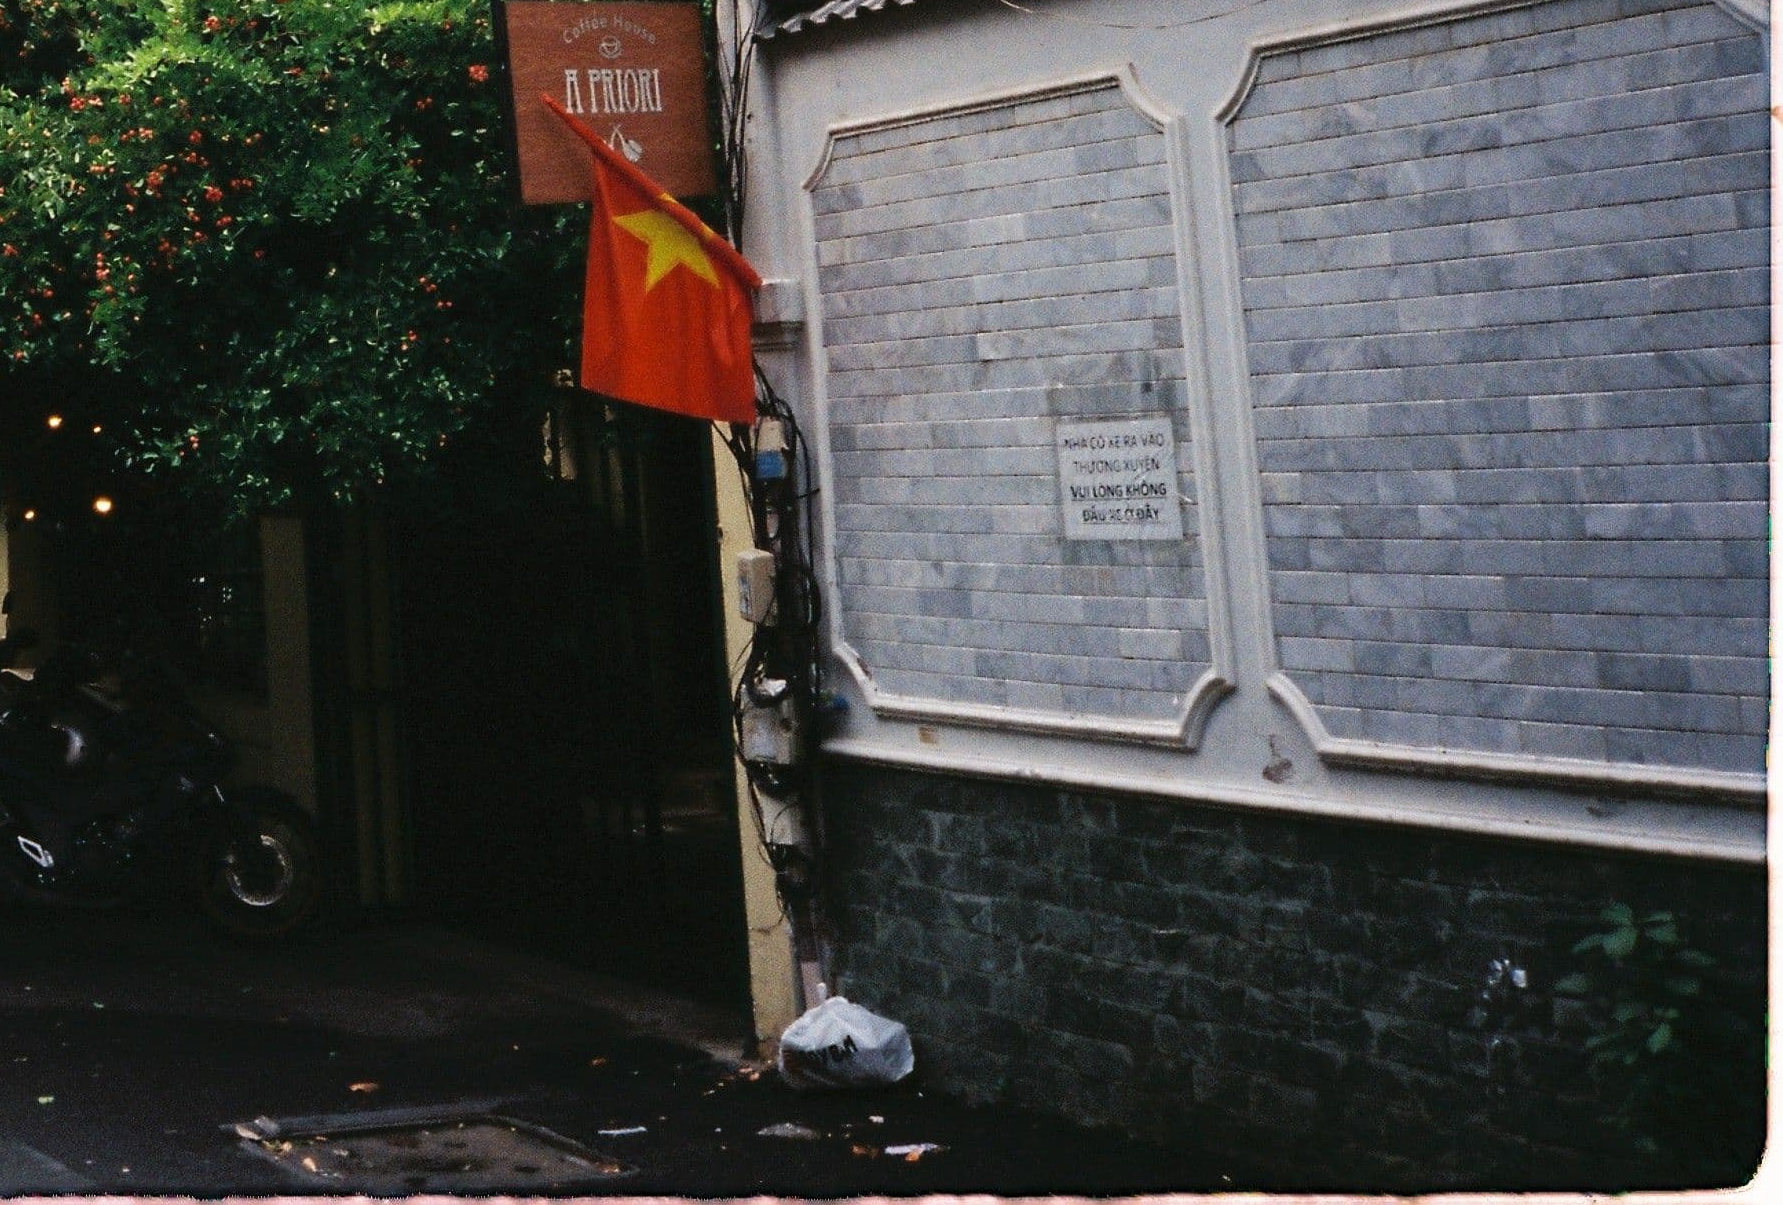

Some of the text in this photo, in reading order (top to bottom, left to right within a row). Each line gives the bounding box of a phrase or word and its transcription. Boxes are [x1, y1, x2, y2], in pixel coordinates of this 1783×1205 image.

[563, 14, 657, 45] Coffee House
[564, 68, 663, 114] A PRIORI
[1070, 485, 1091, 499] VUI
[1125, 480, 1167, 497] KHÔNG
